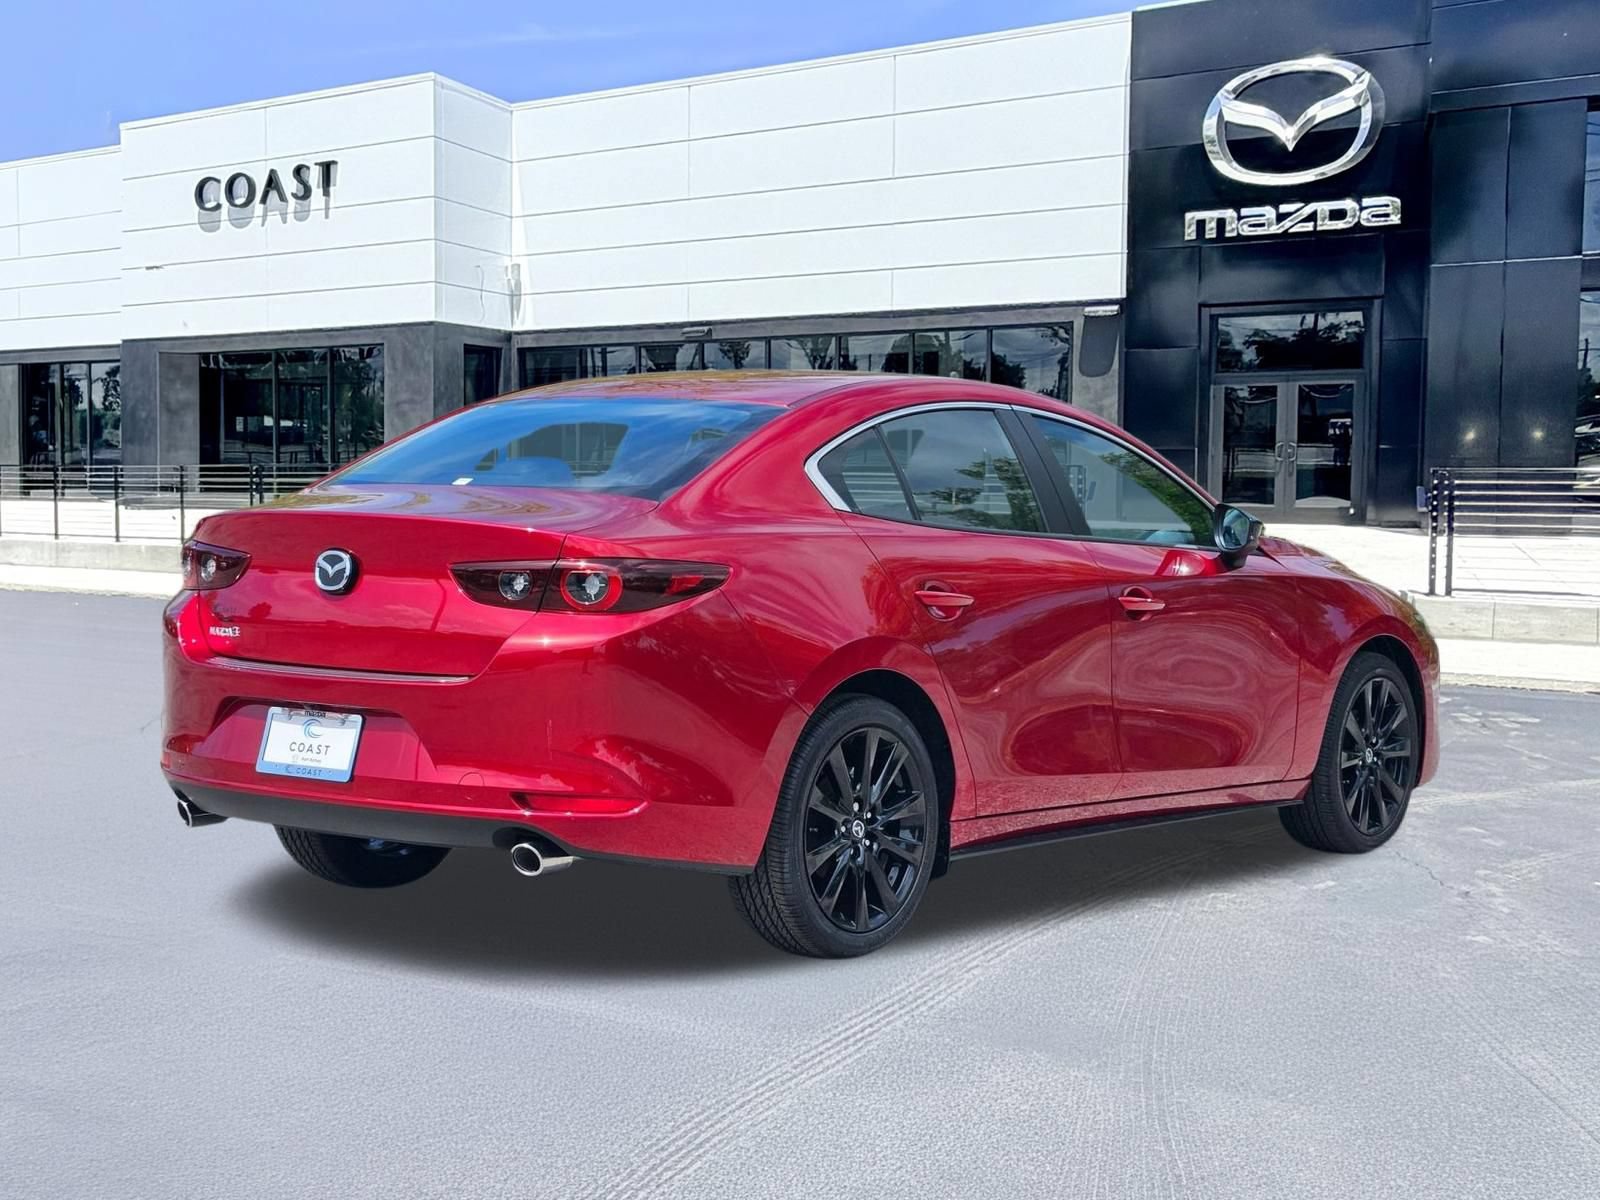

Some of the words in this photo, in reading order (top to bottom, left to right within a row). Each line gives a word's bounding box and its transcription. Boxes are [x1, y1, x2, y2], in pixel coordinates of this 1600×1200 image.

[195, 160, 338, 212] COAST
[1184, 196, 1401, 241] mazda
[289, 741, 331, 756] COAST
[295, 767, 322, 776] COAST
